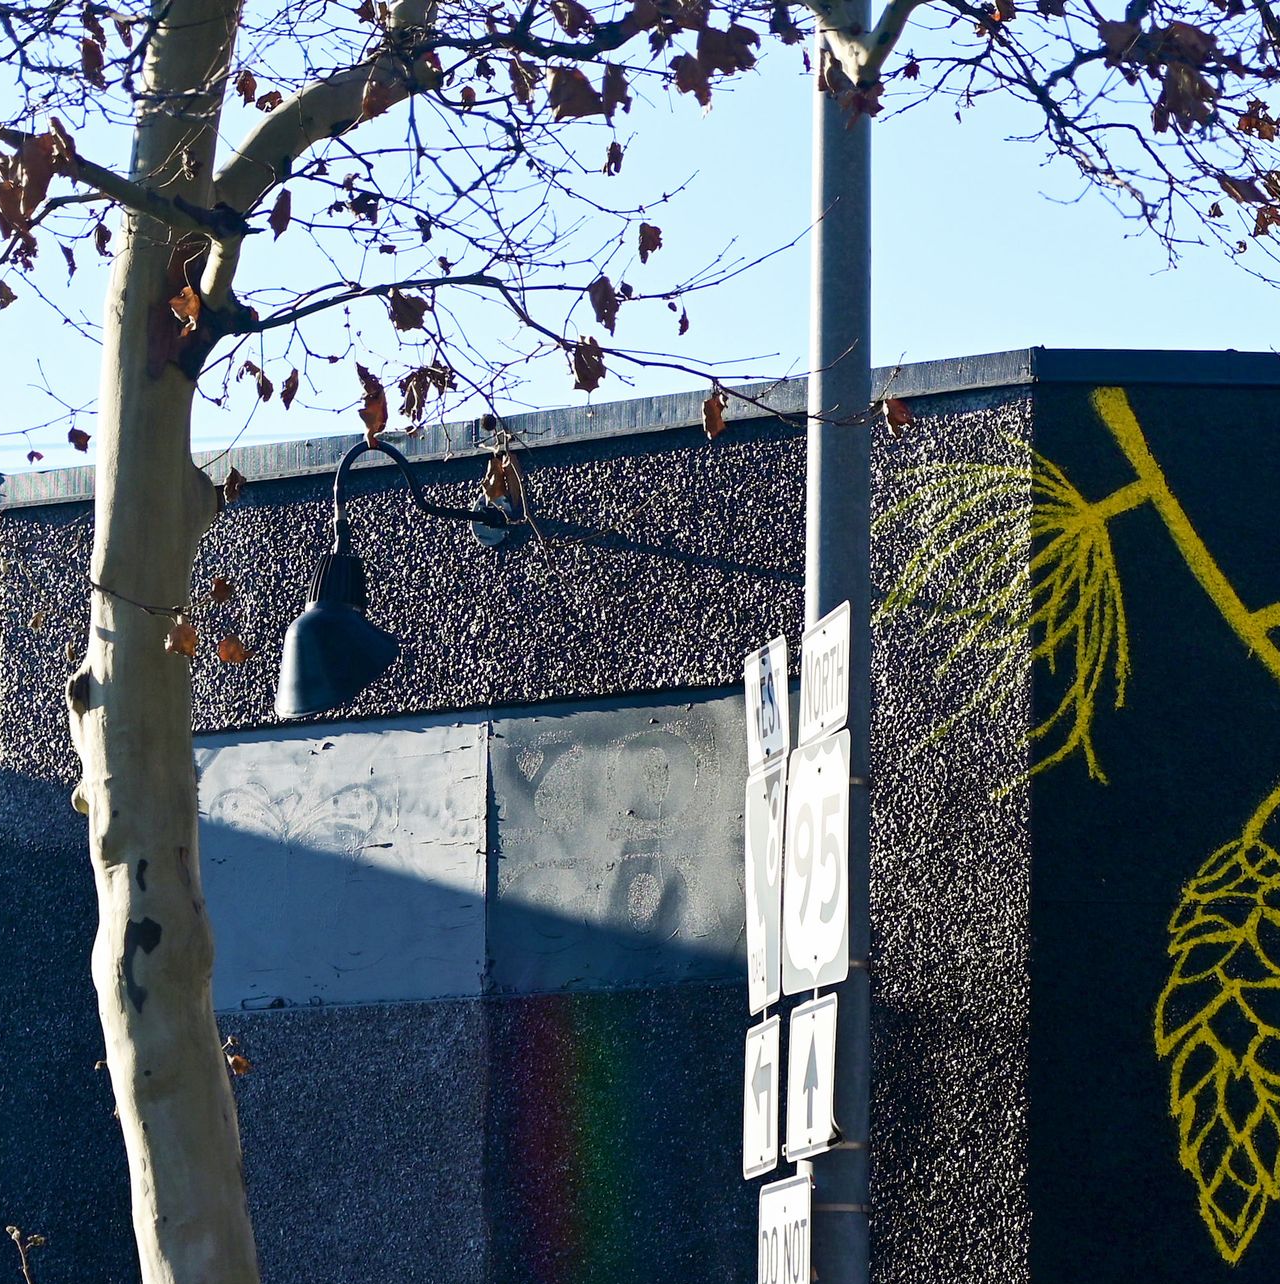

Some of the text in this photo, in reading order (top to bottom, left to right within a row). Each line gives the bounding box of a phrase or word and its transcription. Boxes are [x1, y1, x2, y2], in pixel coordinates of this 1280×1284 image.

[750, 672, 782, 746] WEST
[803, 639, 845, 726] NORTH
[766, 780, 781, 887] 8
[793, 793, 841, 928] 95
